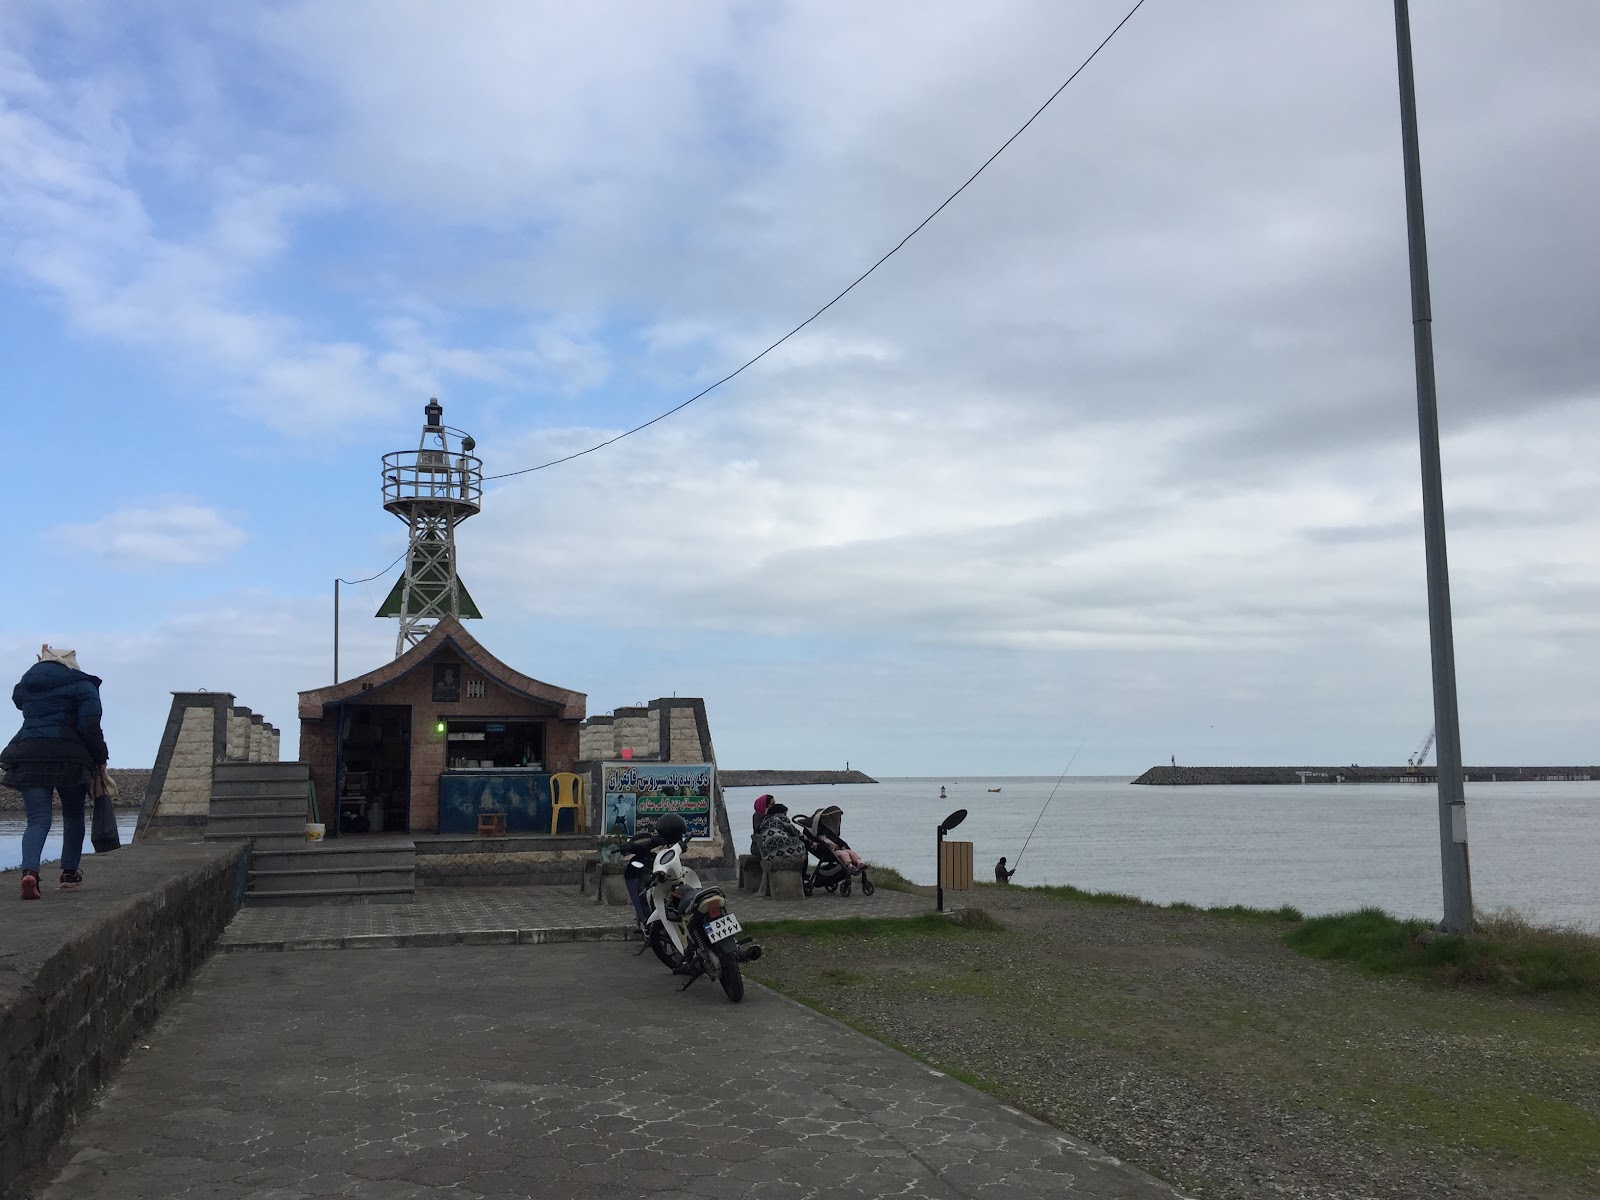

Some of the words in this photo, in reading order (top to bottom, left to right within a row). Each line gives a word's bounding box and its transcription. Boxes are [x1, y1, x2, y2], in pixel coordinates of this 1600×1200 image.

[608, 768, 637, 791] قایقران
[638, 775, 668, 791] سیروس
[668, 770, 680, 790] یاد
[680, 772, 695, 790] زنده
[716, 917, 733, 928] ۵۷۹
